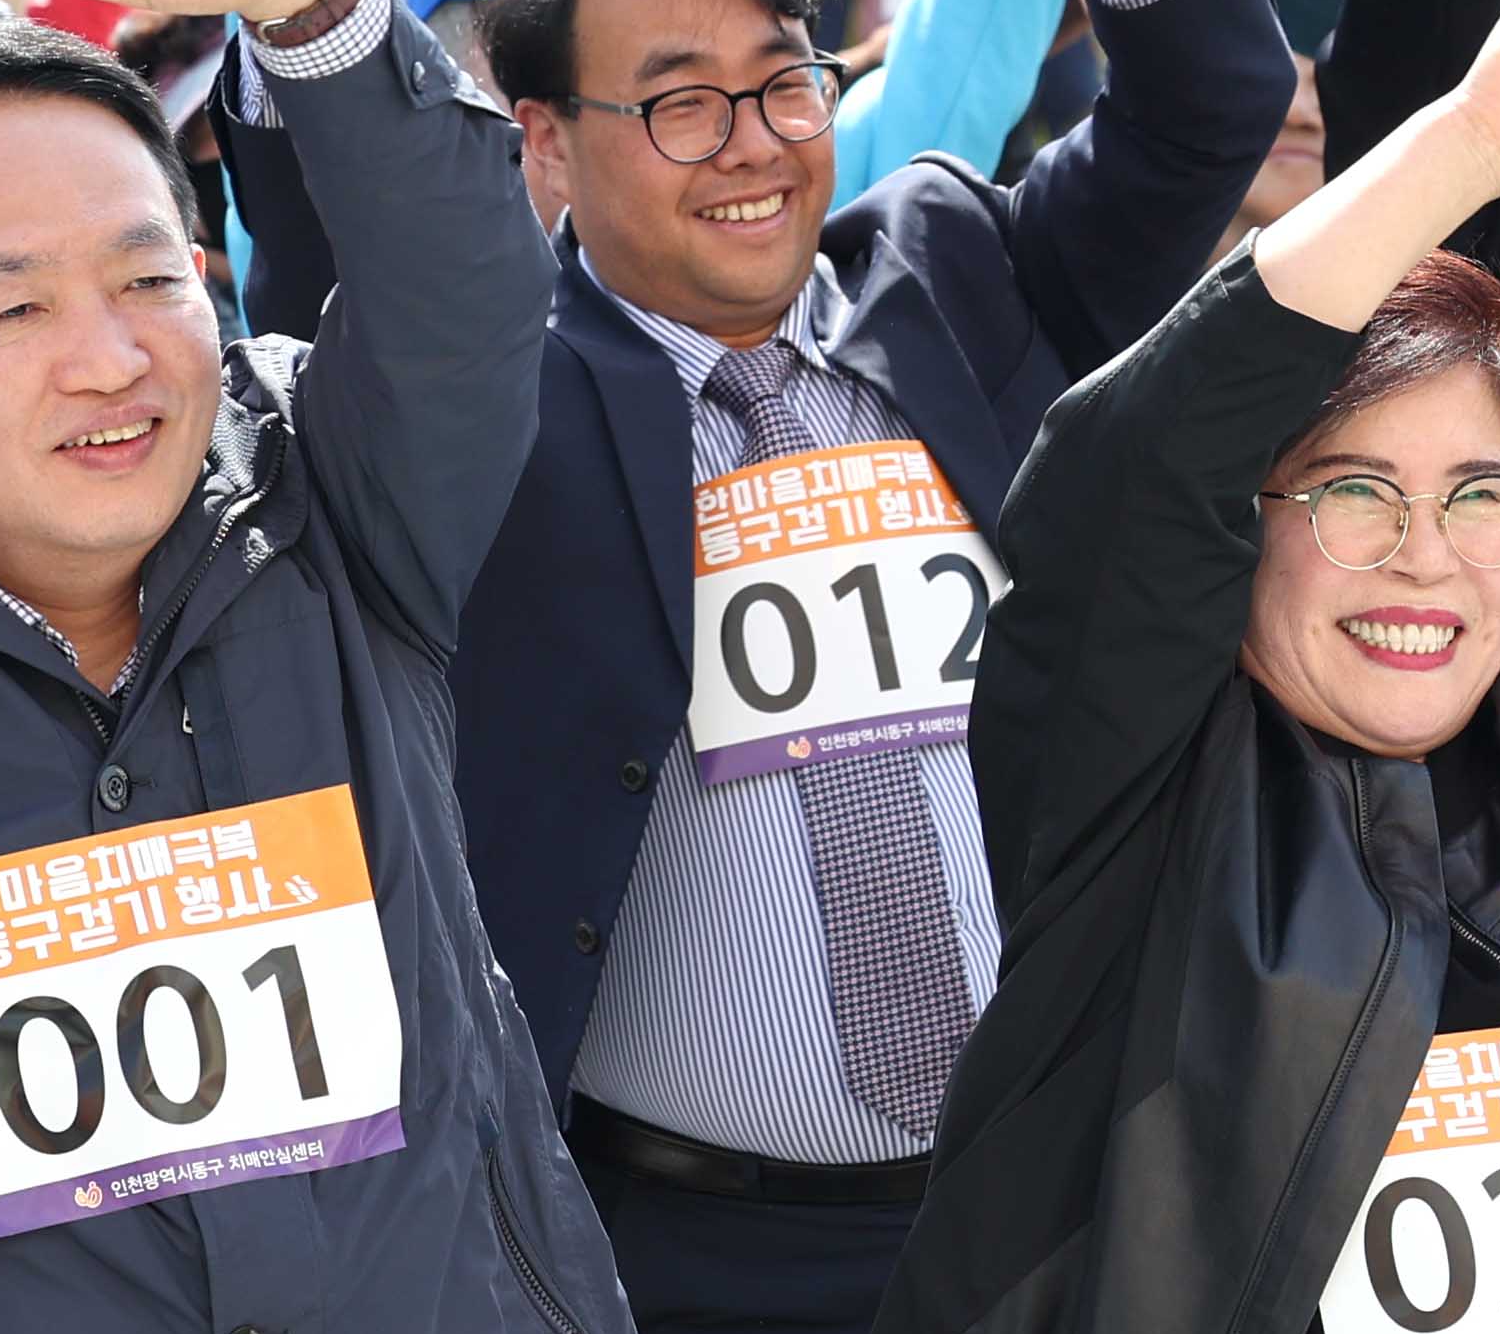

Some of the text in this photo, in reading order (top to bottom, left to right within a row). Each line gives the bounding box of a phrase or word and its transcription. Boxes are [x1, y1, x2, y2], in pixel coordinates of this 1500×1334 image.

[695, 451, 935, 525] 한마음치매극복
[700, 488, 948, 566] 동구걷기 행사
[721, 553, 990, 713] 012
[817, 714, 968, 752] 인천광역시동구 치매안심
[174, 866, 274, 925] 행사
[110, 1139, 325, 1199] 인천광역시동구 치매안심센터
